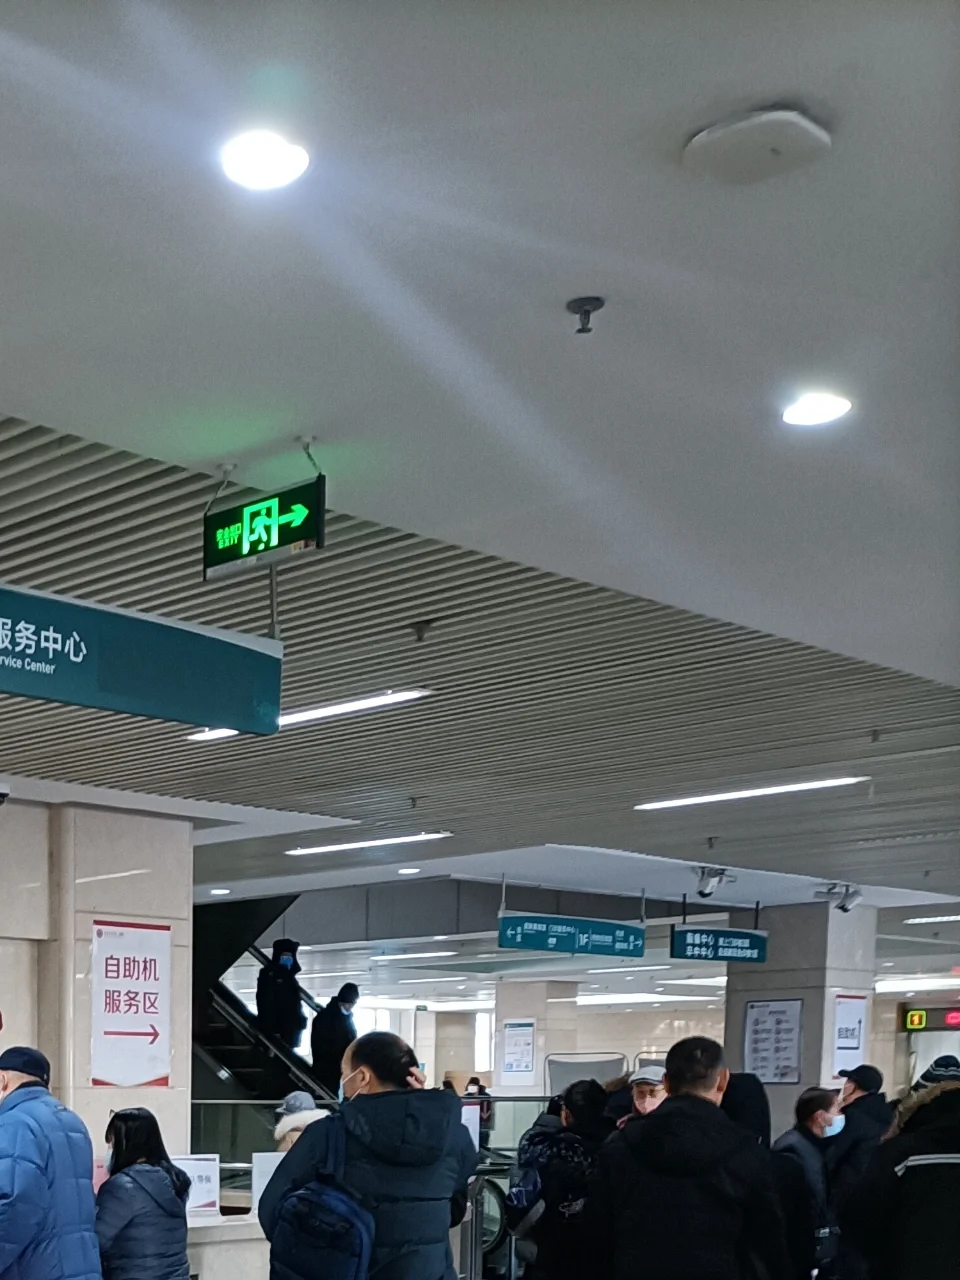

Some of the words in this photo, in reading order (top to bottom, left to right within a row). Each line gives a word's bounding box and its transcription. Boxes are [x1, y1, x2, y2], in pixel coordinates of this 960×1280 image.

[218, 534, 239, 549] EXIT
[24, 658, 56, 675] Center
[579, 933, 589, 946] 1F
[104, 954, 159, 982] 自助机
[104, 989, 160, 1015] 服务区
